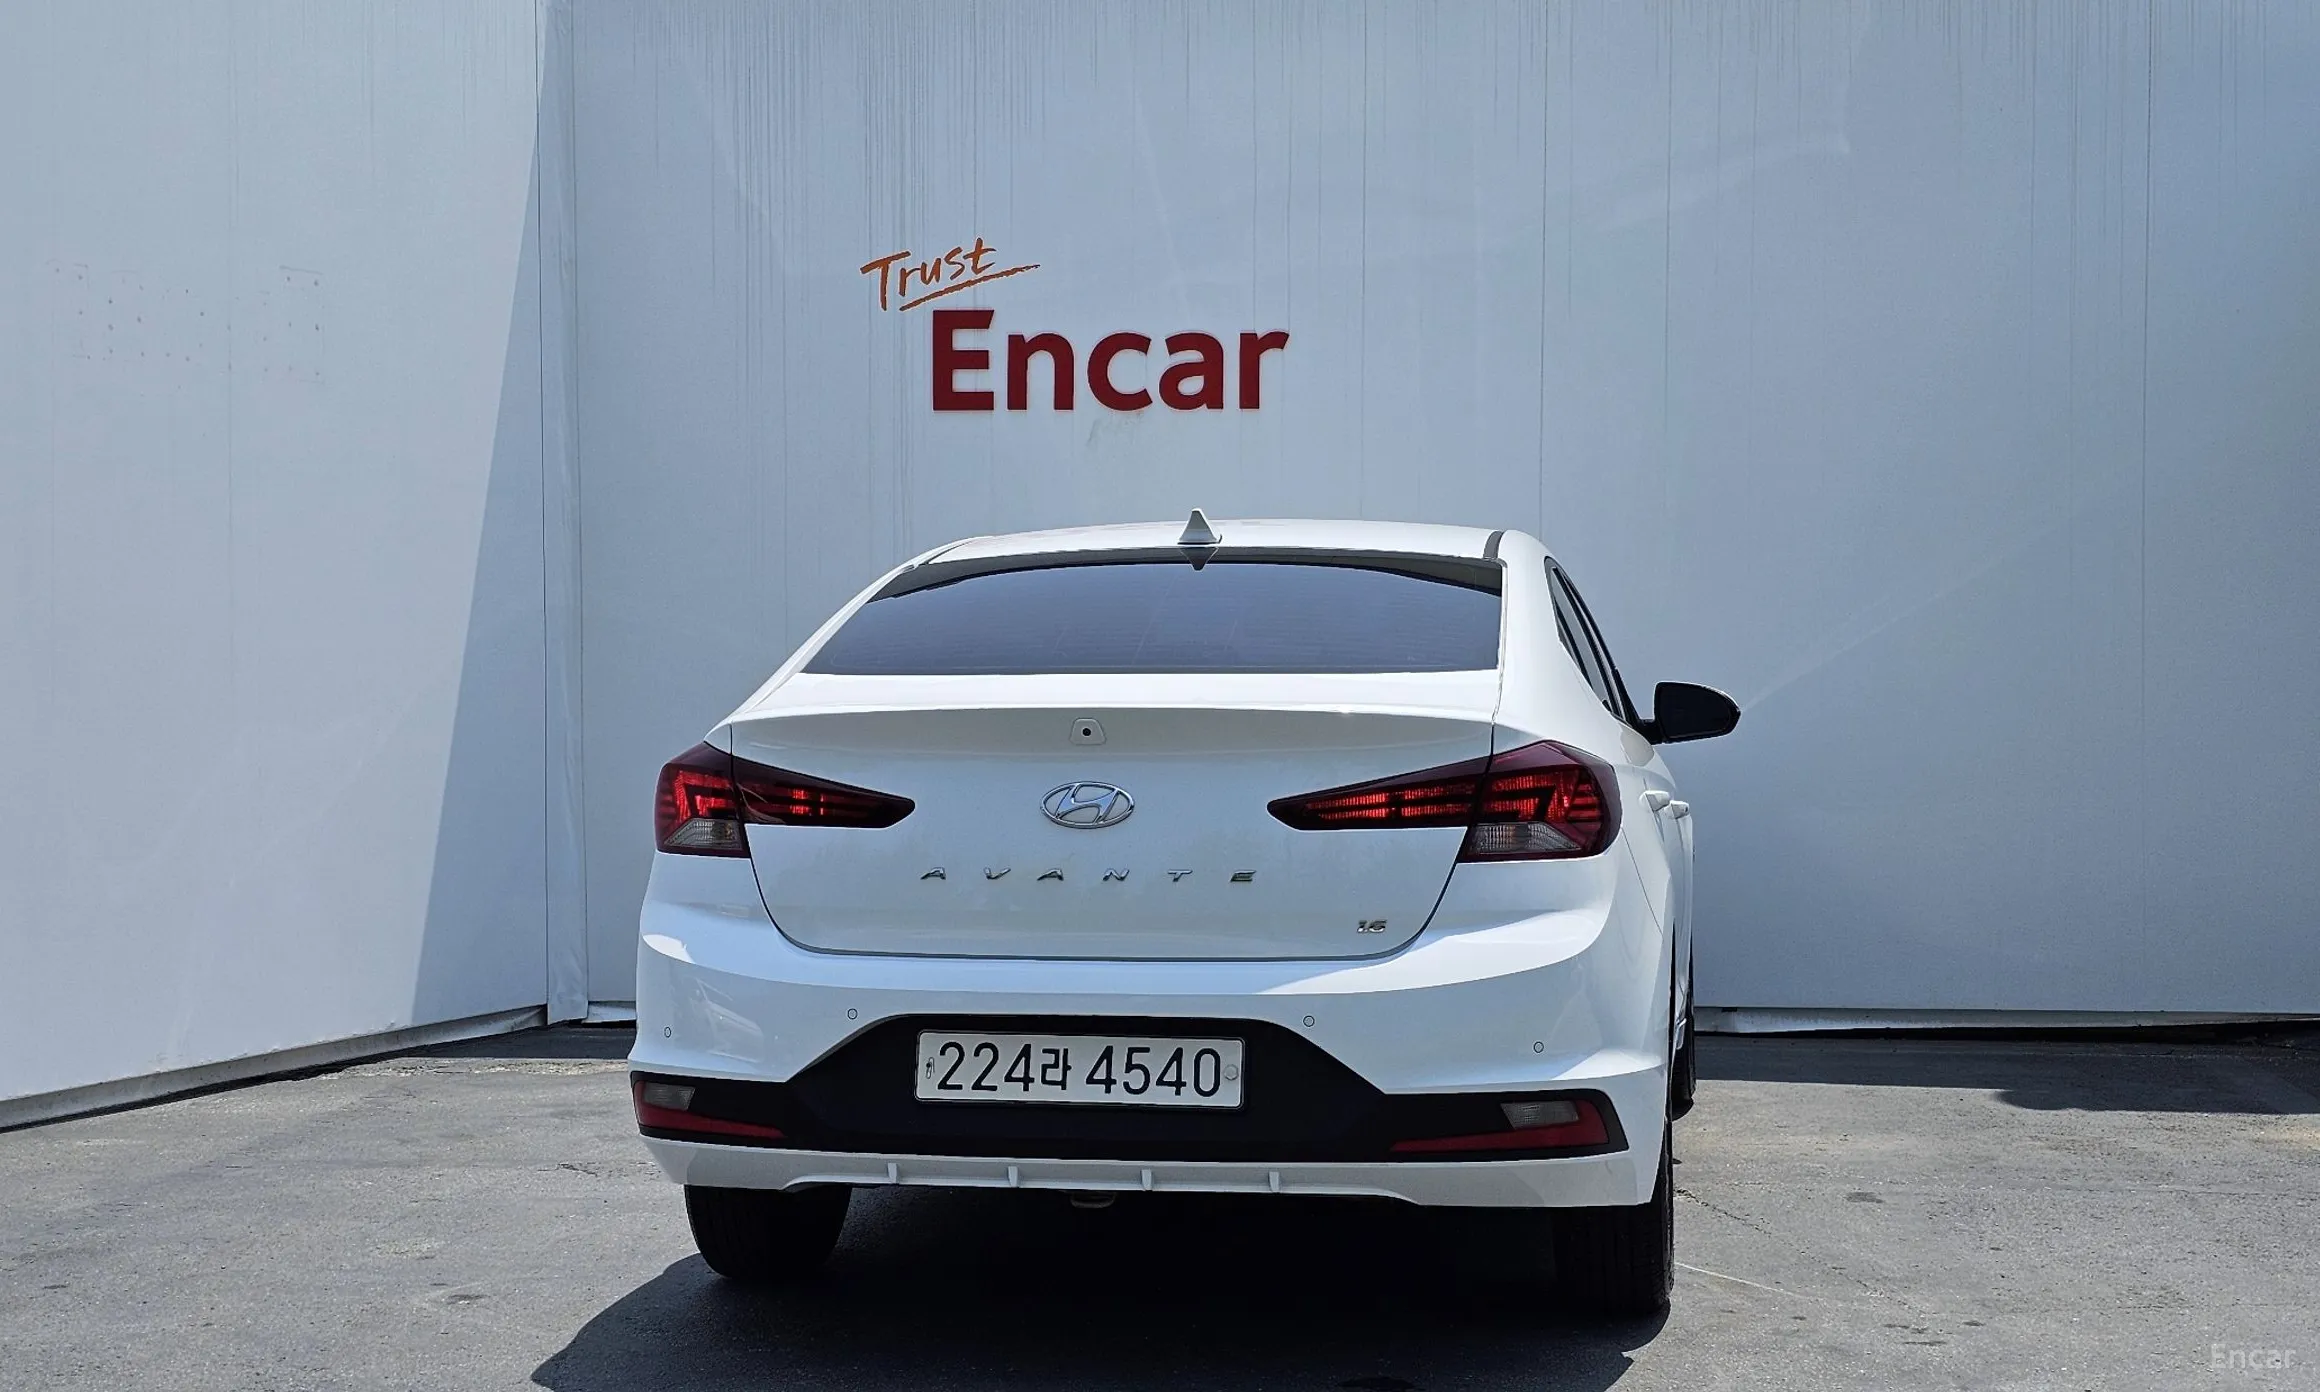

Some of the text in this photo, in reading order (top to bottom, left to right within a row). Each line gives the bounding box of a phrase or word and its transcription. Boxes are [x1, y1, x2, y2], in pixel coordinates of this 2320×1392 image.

[860, 237, 997, 311] Trust
[932, 309, 1290, 411] Encar
[920, 867, 1257, 883] AVANTE
[937, 1041, 1221, 1098] 224라 4540
